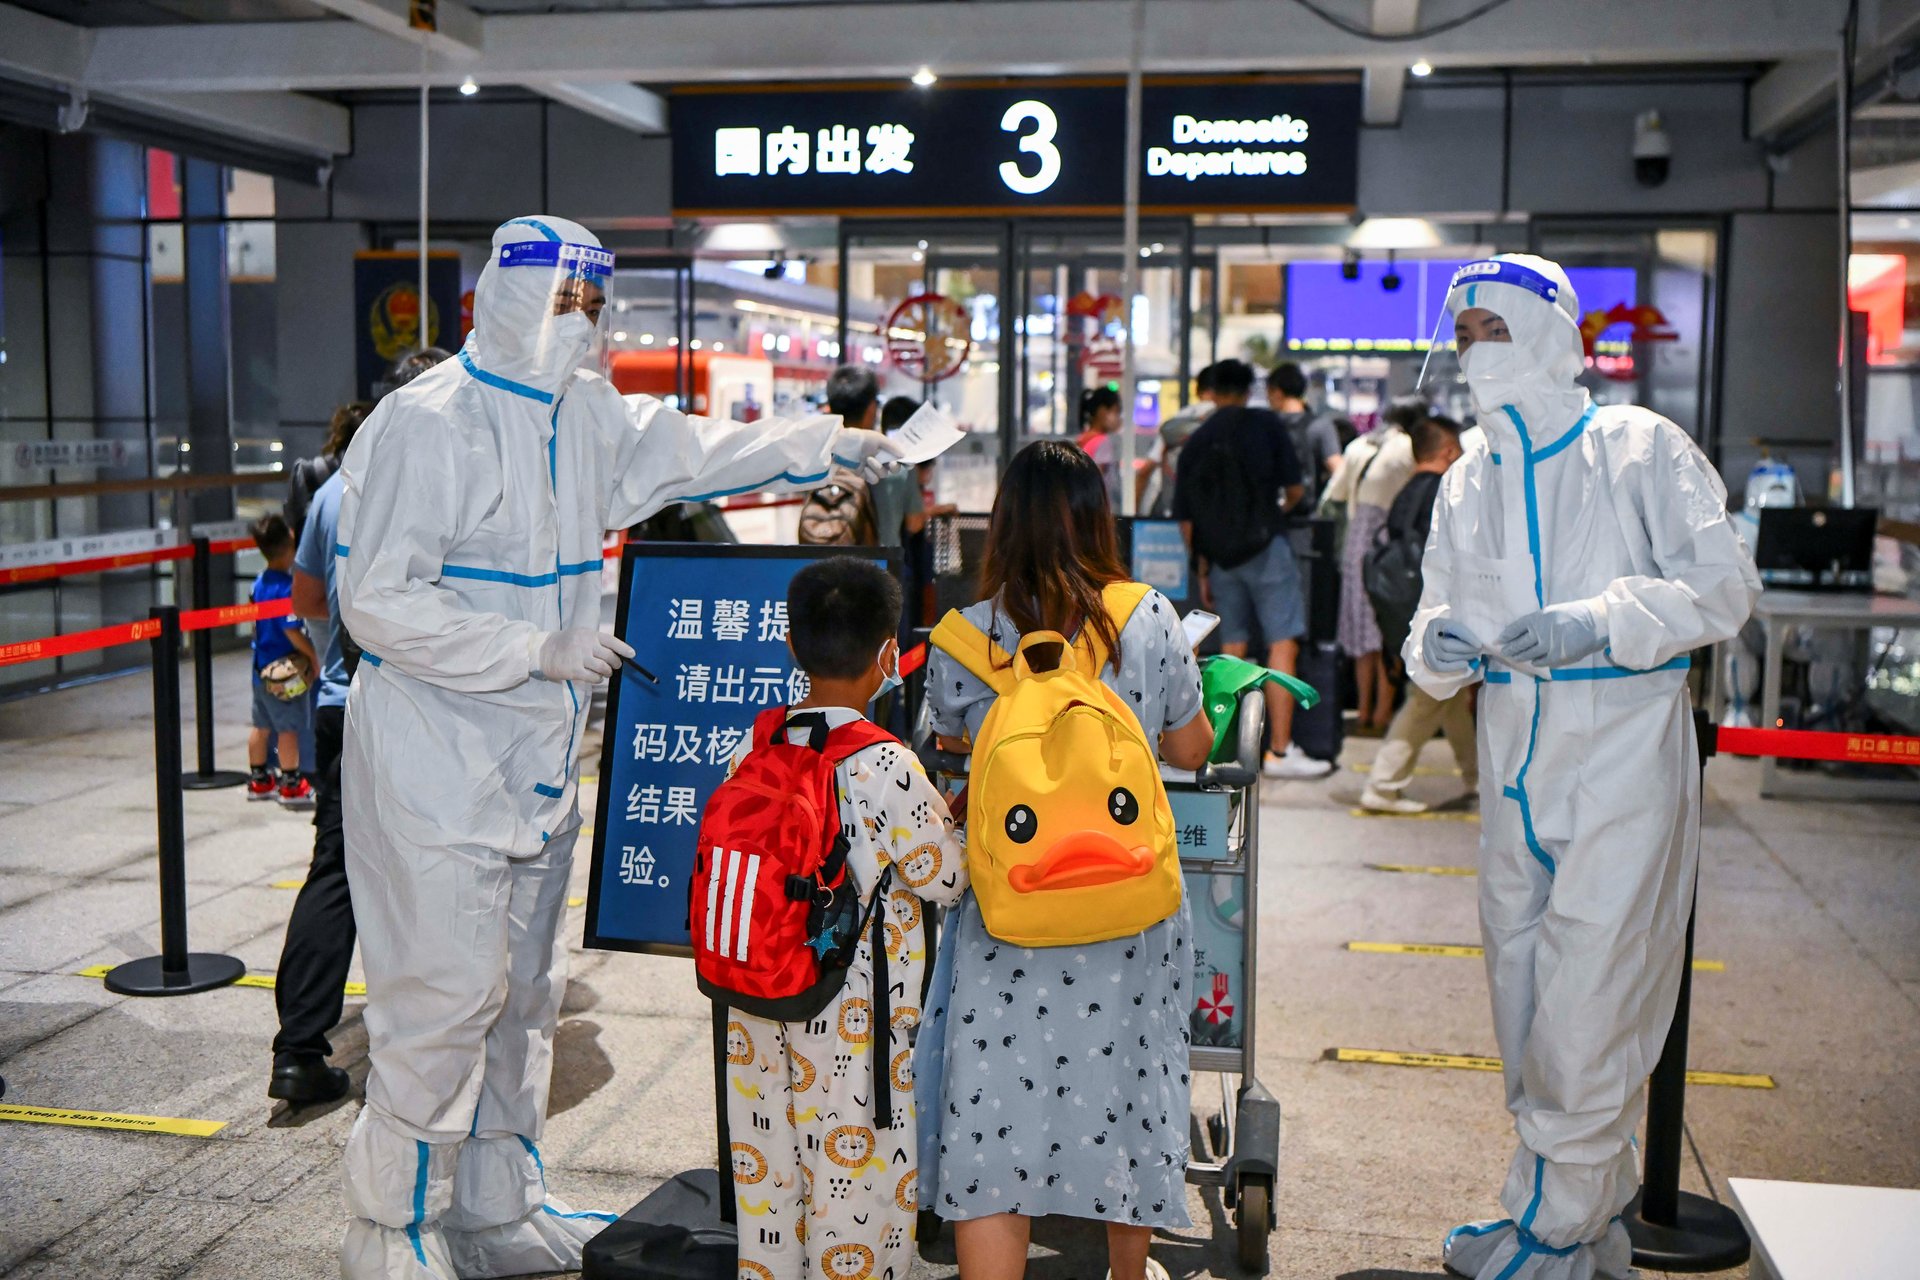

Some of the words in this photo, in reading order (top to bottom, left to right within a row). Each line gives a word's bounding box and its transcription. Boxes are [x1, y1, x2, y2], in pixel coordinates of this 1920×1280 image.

[714, 122, 916, 177] 国内出发
[999, 100, 1062, 195] 3
[1173, 114, 1309, 144] Domestic
[1147, 147, 1308, 181] Departures
[667, 598, 791, 642] 温馨提
[675, 663, 811, 706] 请出示健
[632, 723, 754, 766] 码及核
[625, 783, 698, 826] 结果
[618, 845, 670, 889] 验。
[24, 1110, 57, 1118] Keep
[70, 1113, 98, 1121] Safe
[100, 1116, 156, 1126] Distance
